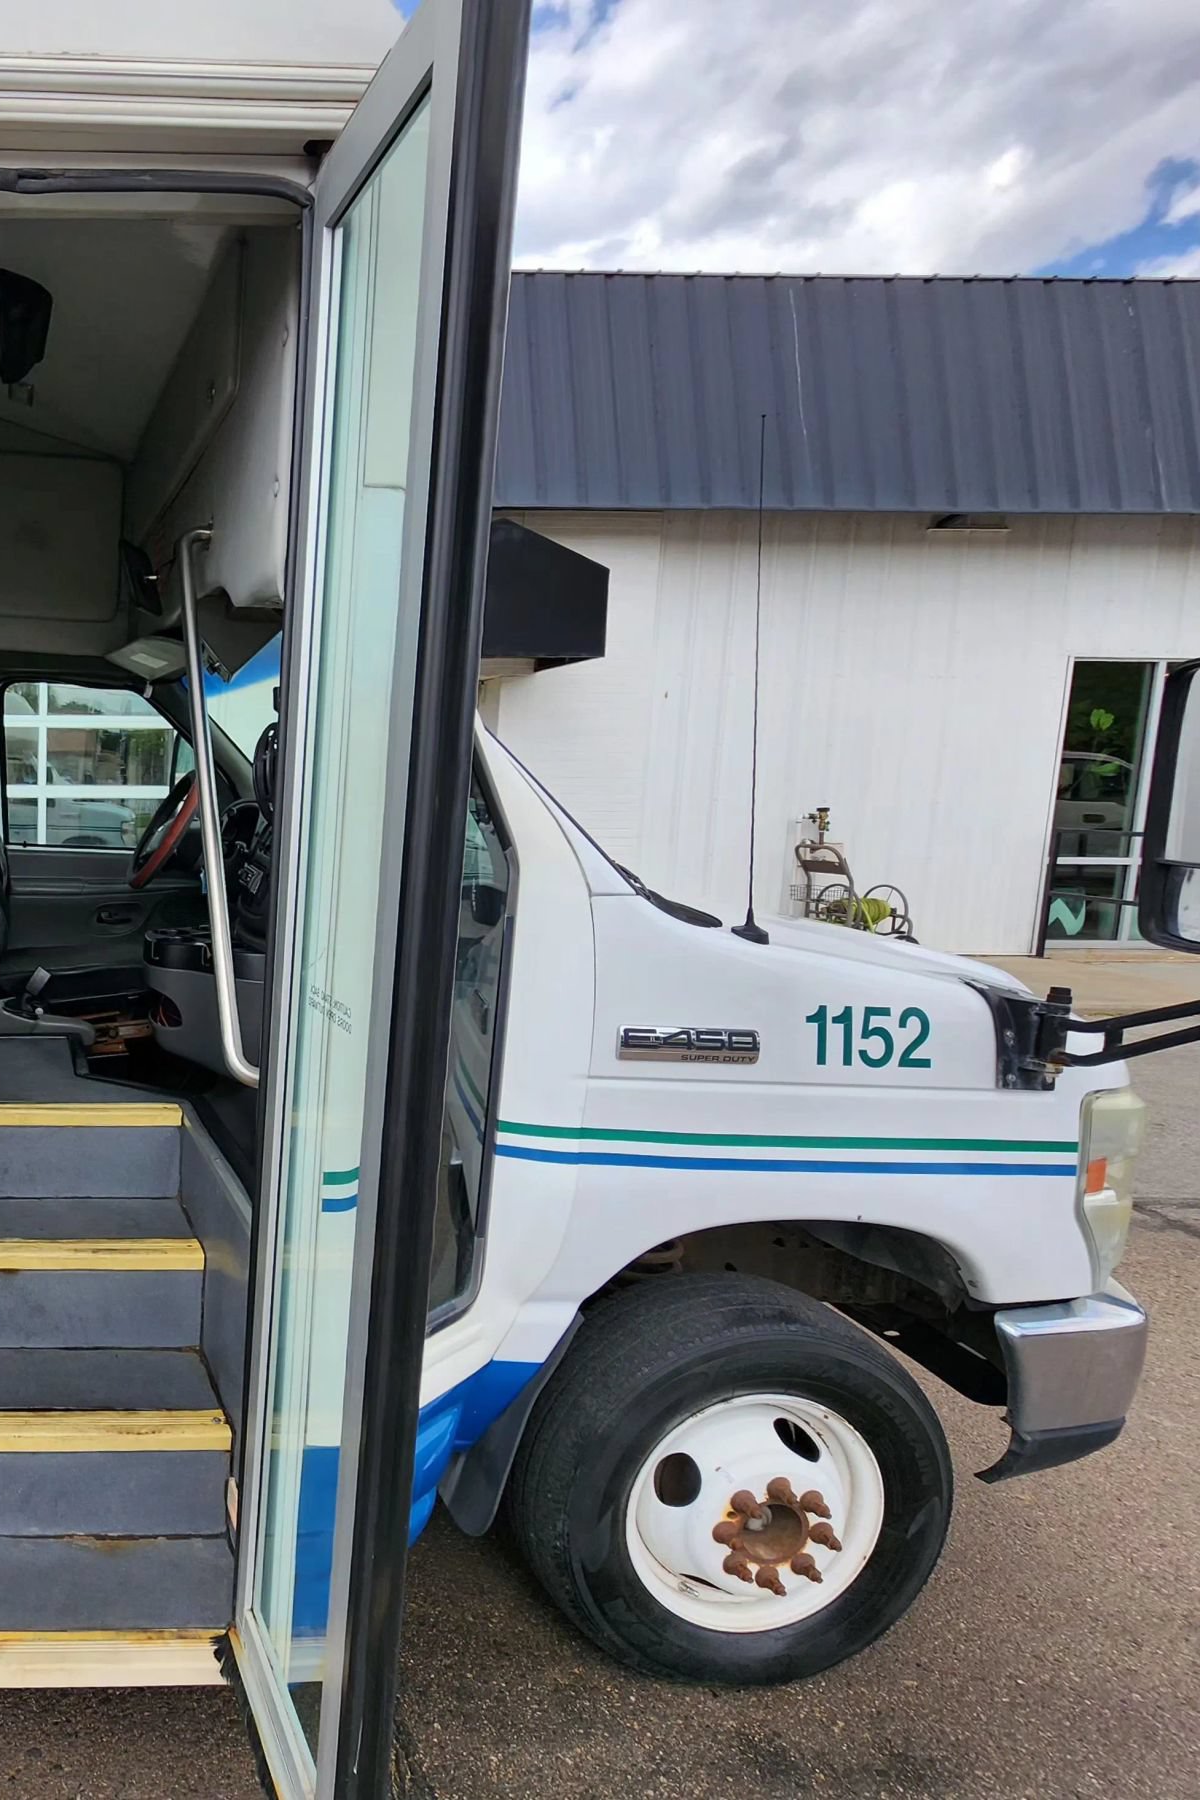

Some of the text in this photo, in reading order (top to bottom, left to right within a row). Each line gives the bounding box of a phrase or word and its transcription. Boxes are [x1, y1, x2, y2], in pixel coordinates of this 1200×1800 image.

[805, 1004, 932, 1069] 1152
[680, 1054, 756, 1064] SUPER DUTY
